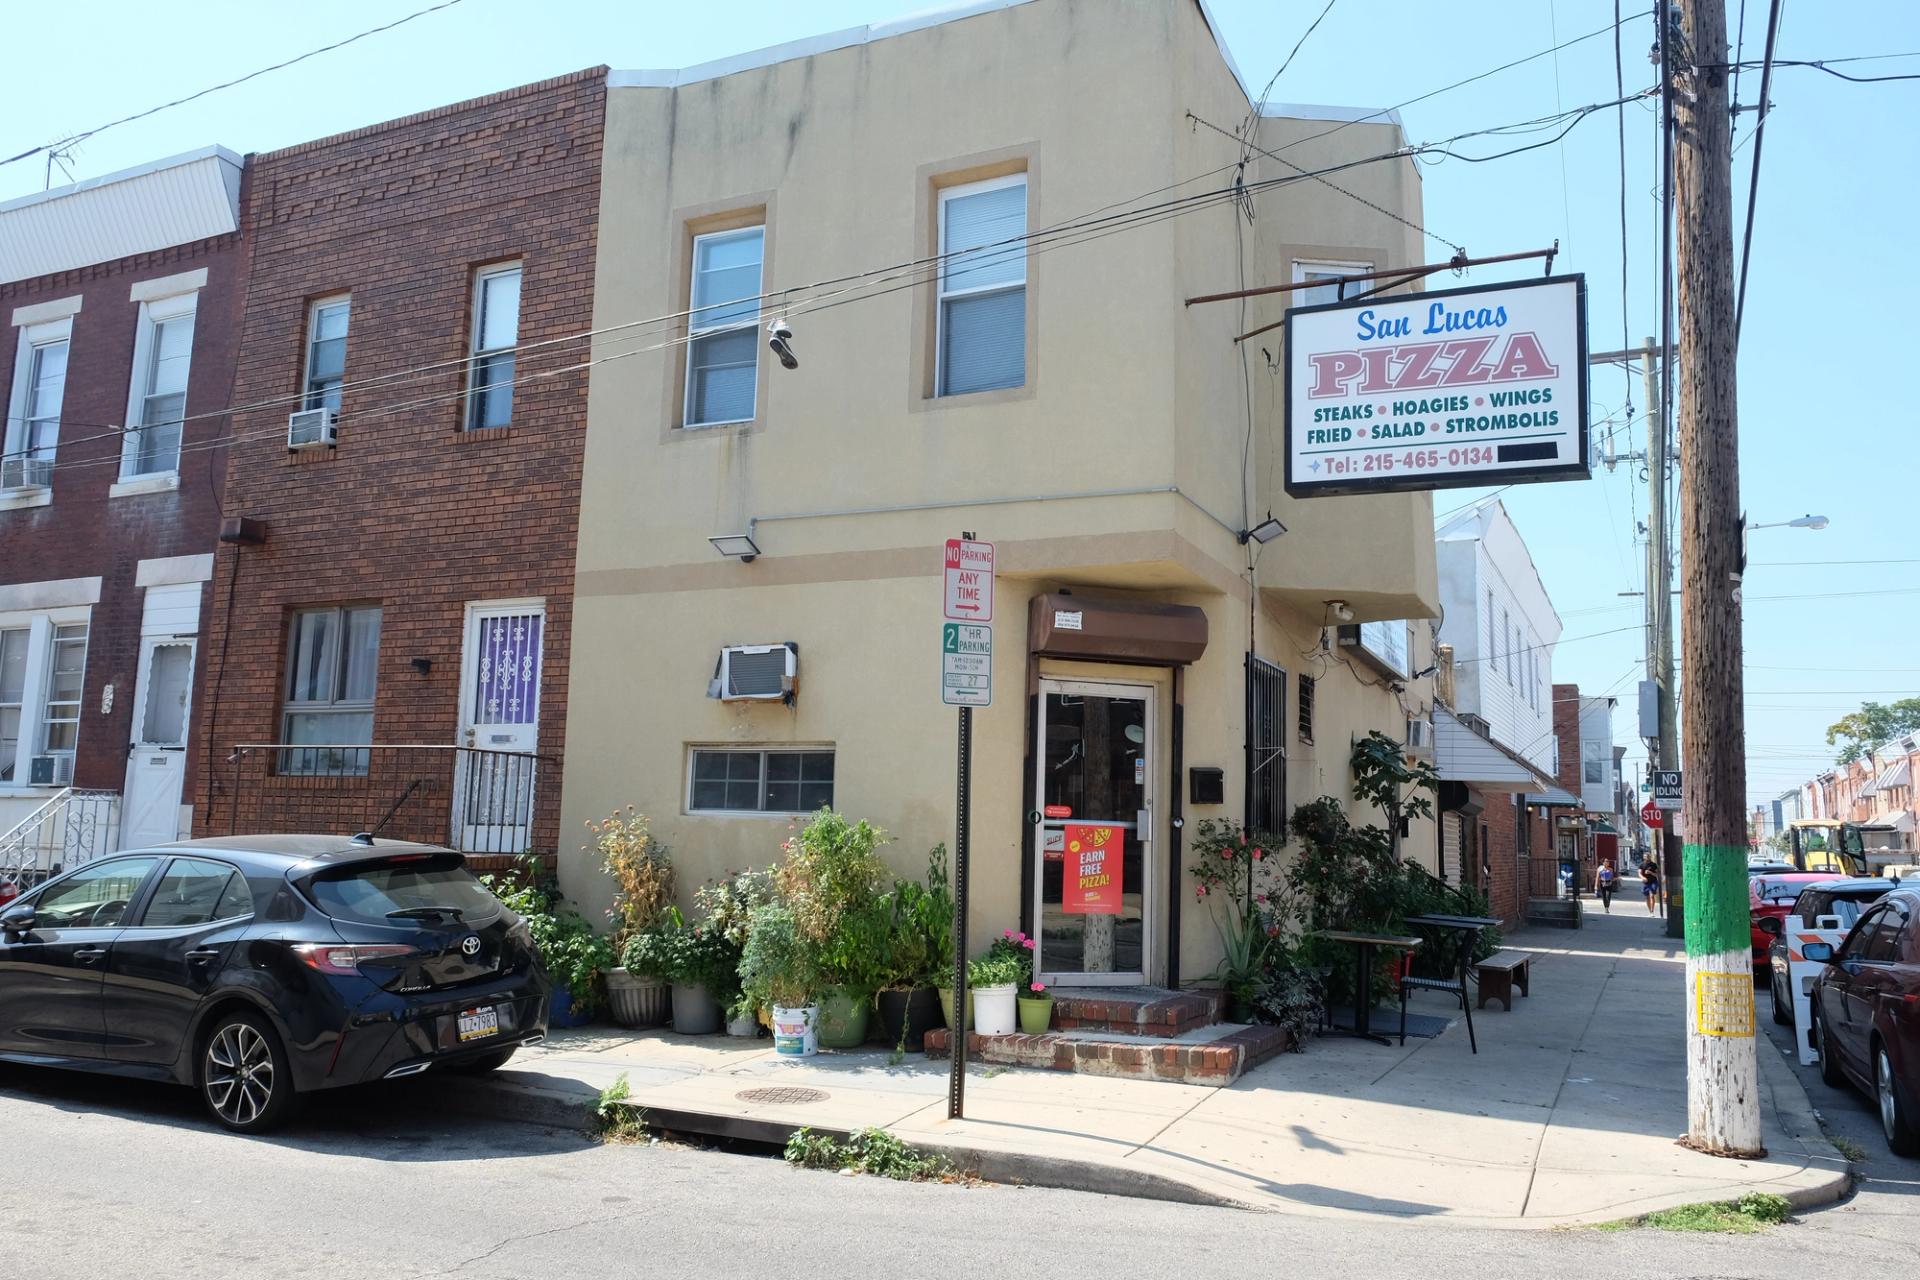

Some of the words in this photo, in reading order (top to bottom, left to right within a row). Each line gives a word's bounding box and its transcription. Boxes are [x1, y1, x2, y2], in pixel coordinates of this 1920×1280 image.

[1357, 310, 1411, 341] San
[1423, 302, 1508, 335] Lucas
[1308, 331, 1559, 400] PIZZA
[1314, 404, 1373, 422] STEAKS
[1393, 395, 1469, 416] HOAGIES
[1489, 388, 1552, 408] WINGS
[1307, 427, 1352, 444] FRIED
[1371, 421, 1426, 440] SALAD
[1446, 410, 1559, 434] STROMBOLIS
[1325, 455, 1358, 474] Tel:
[1363, 446, 1493, 472] 215-465-0134
[947, 547, 959, 562] NO
[961, 550, 992, 562] PARKING
[959, 572, 979, 585] ANY
[957, 587, 980, 600] TIME
[946, 628, 955, 649] 2
[969, 629, 981, 639] HR
[959, 640, 990, 652] PARKING
[1662, 773, 1678, 785] NO
[1643, 810, 1661, 821] STO
[1080, 850, 1105, 864] EARN
[1080, 863, 1102, 877] FREE
[1080, 874, 1110, 889] PIZZA!
